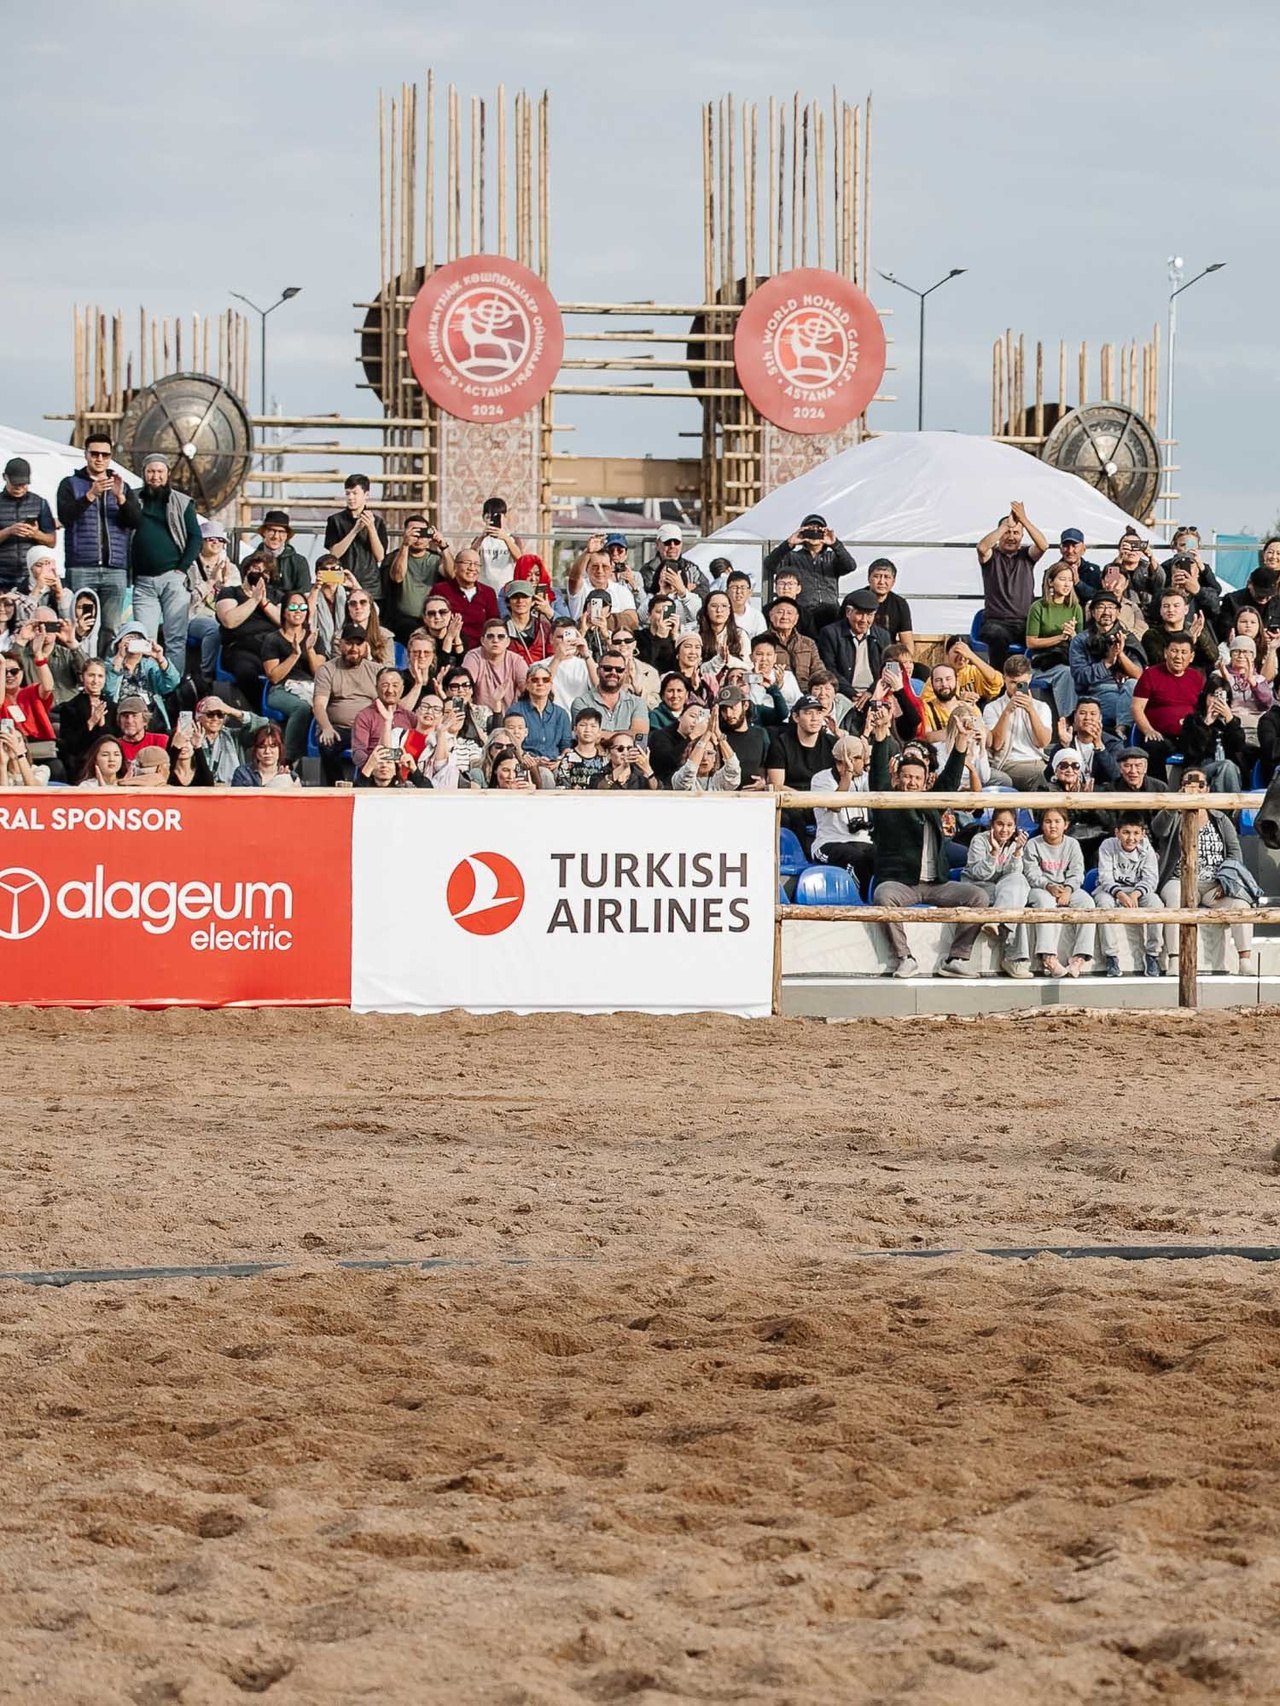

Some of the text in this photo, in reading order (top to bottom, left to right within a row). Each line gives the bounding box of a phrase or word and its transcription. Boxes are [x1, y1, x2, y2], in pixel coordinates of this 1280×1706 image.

[762, 294, 860, 382] 5th WORLD NOMAD GAMES
[463, 383, 512, 397] АСТАНА
[783, 386, 836, 401] ASTANA
[472, 404, 504, 416] 2024
[793, 407, 826, 419] 2024
[51, 808, 182, 831] SPONSOR
[550, 852, 748, 888] TURKISH
[56, 864, 293, 935] alageum
[546, 898, 751, 934] AIRLINES
[190, 922, 293, 951] electric
